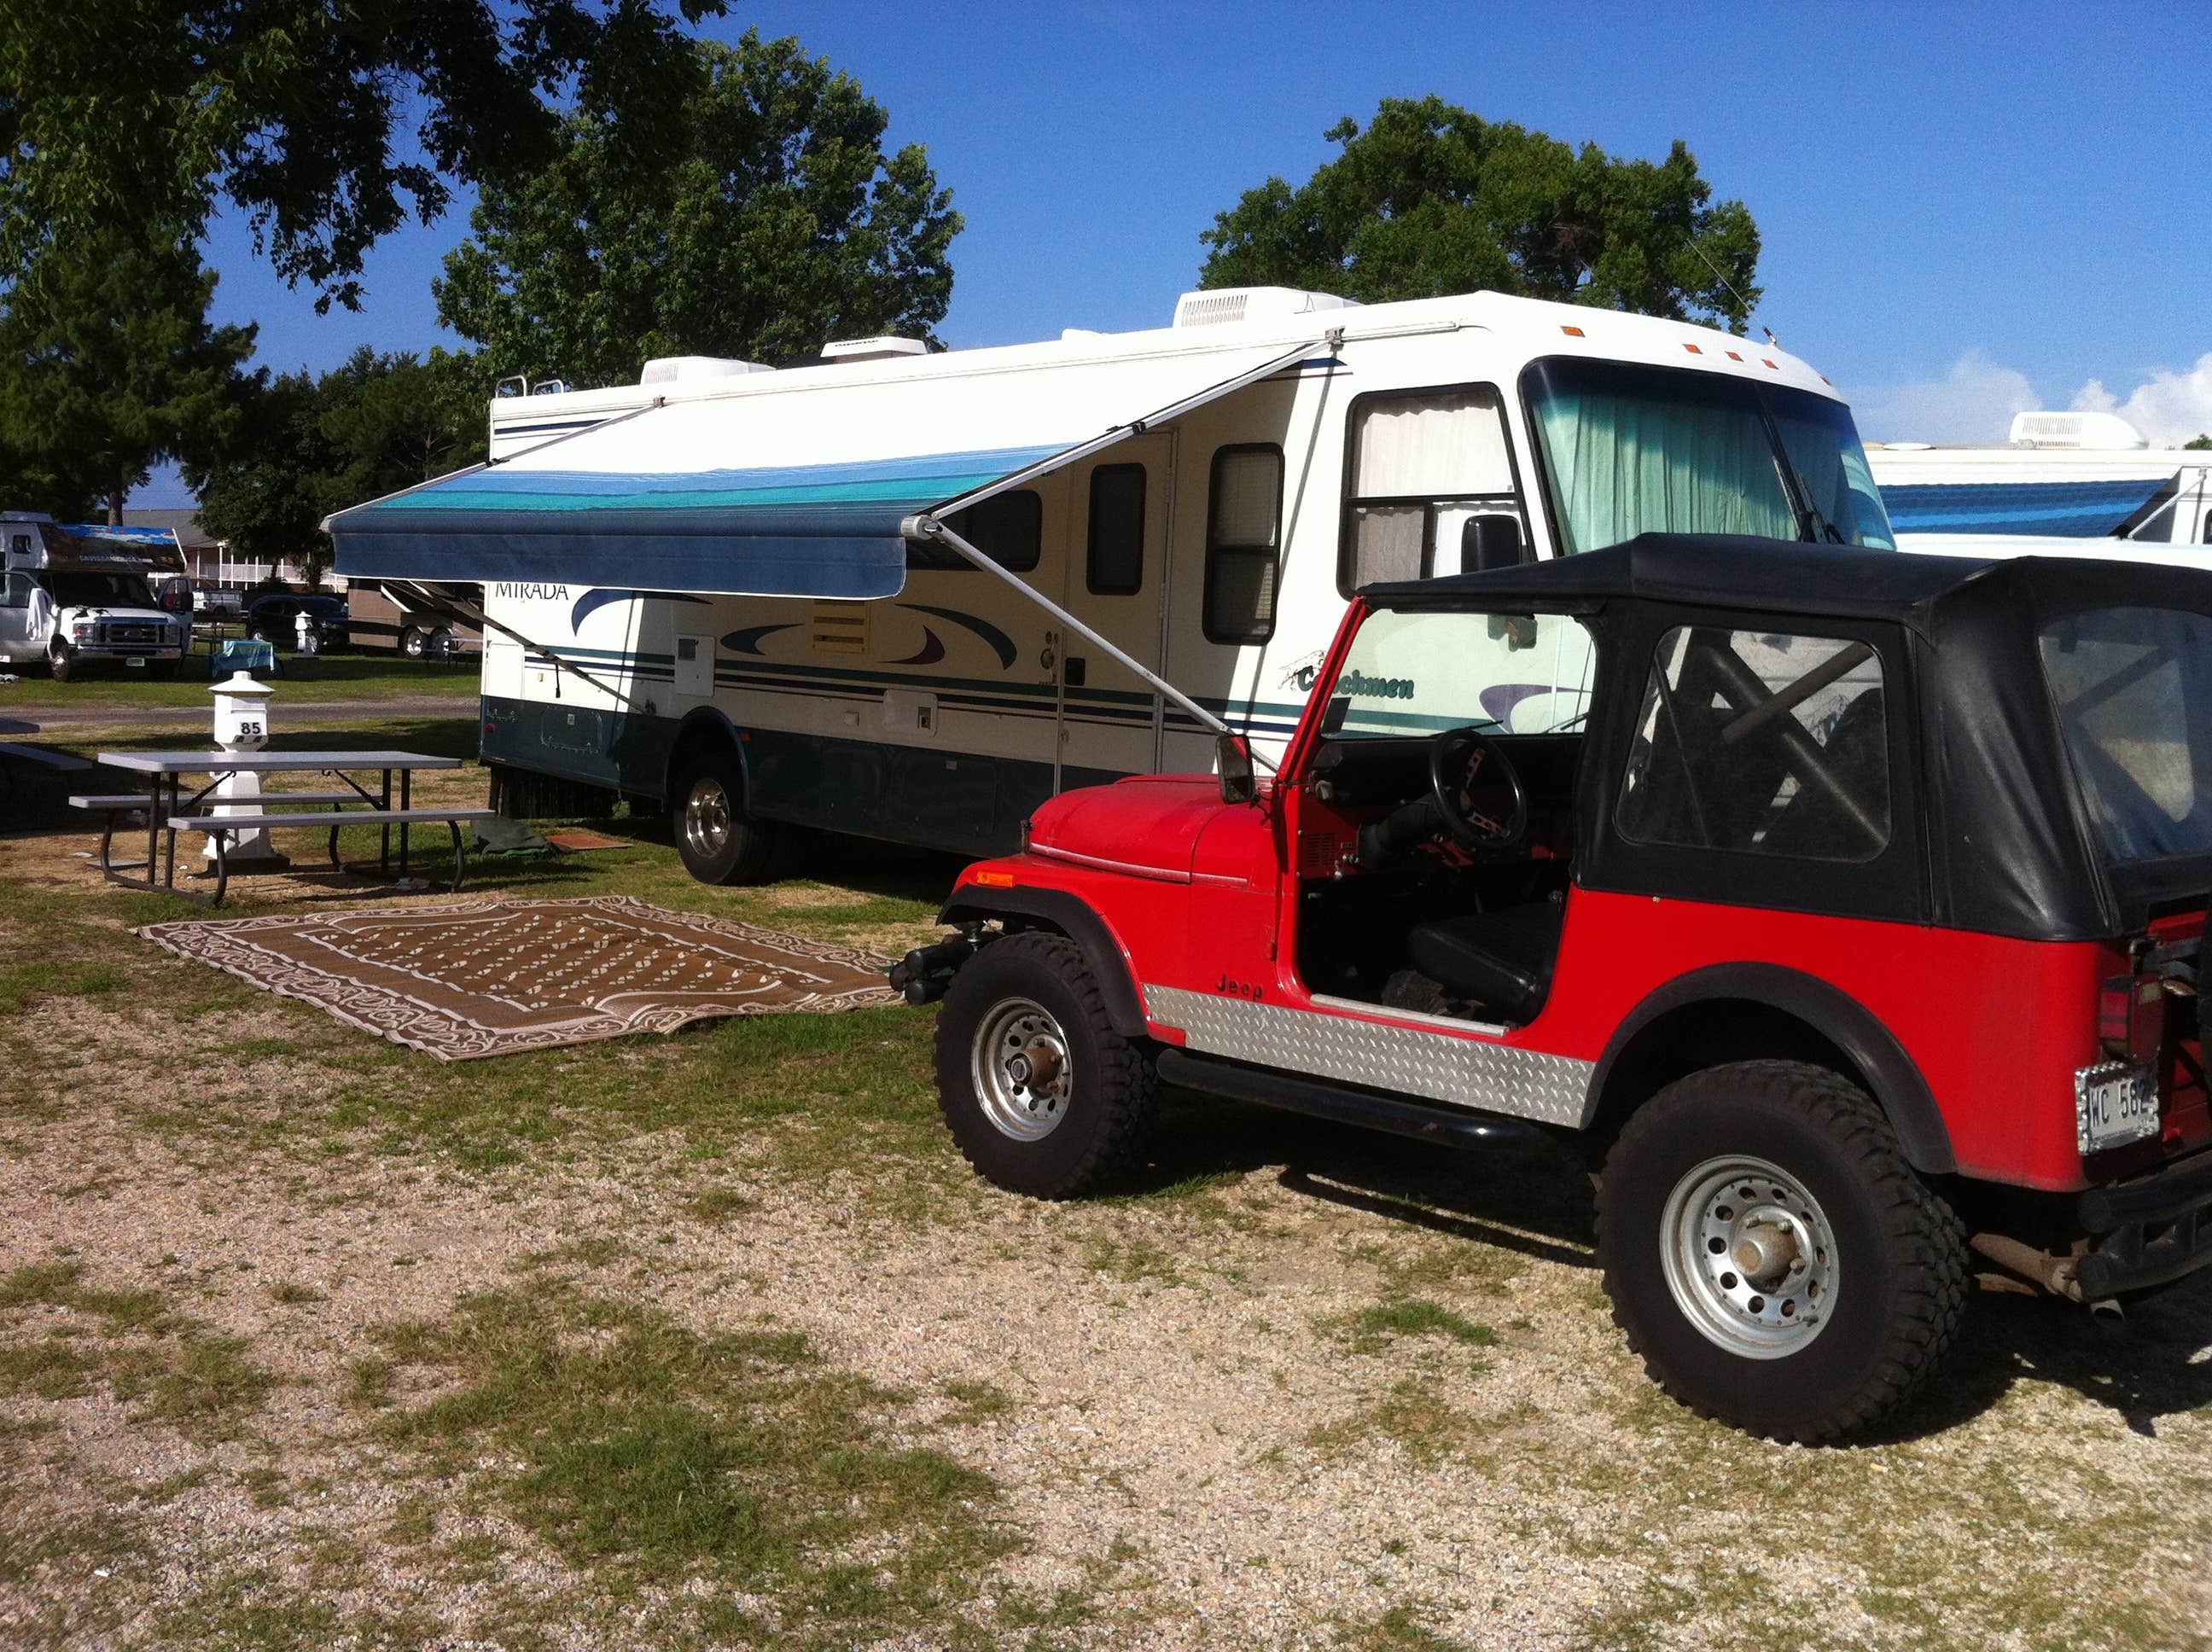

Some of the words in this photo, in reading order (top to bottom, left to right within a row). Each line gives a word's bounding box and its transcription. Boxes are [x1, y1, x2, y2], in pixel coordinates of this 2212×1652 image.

[495, 582, 568, 601] MIRADA
[1297, 665, 1415, 700] Cchmen
[241, 722, 261, 735] 85
[1217, 974, 1264, 1003] Jeep
